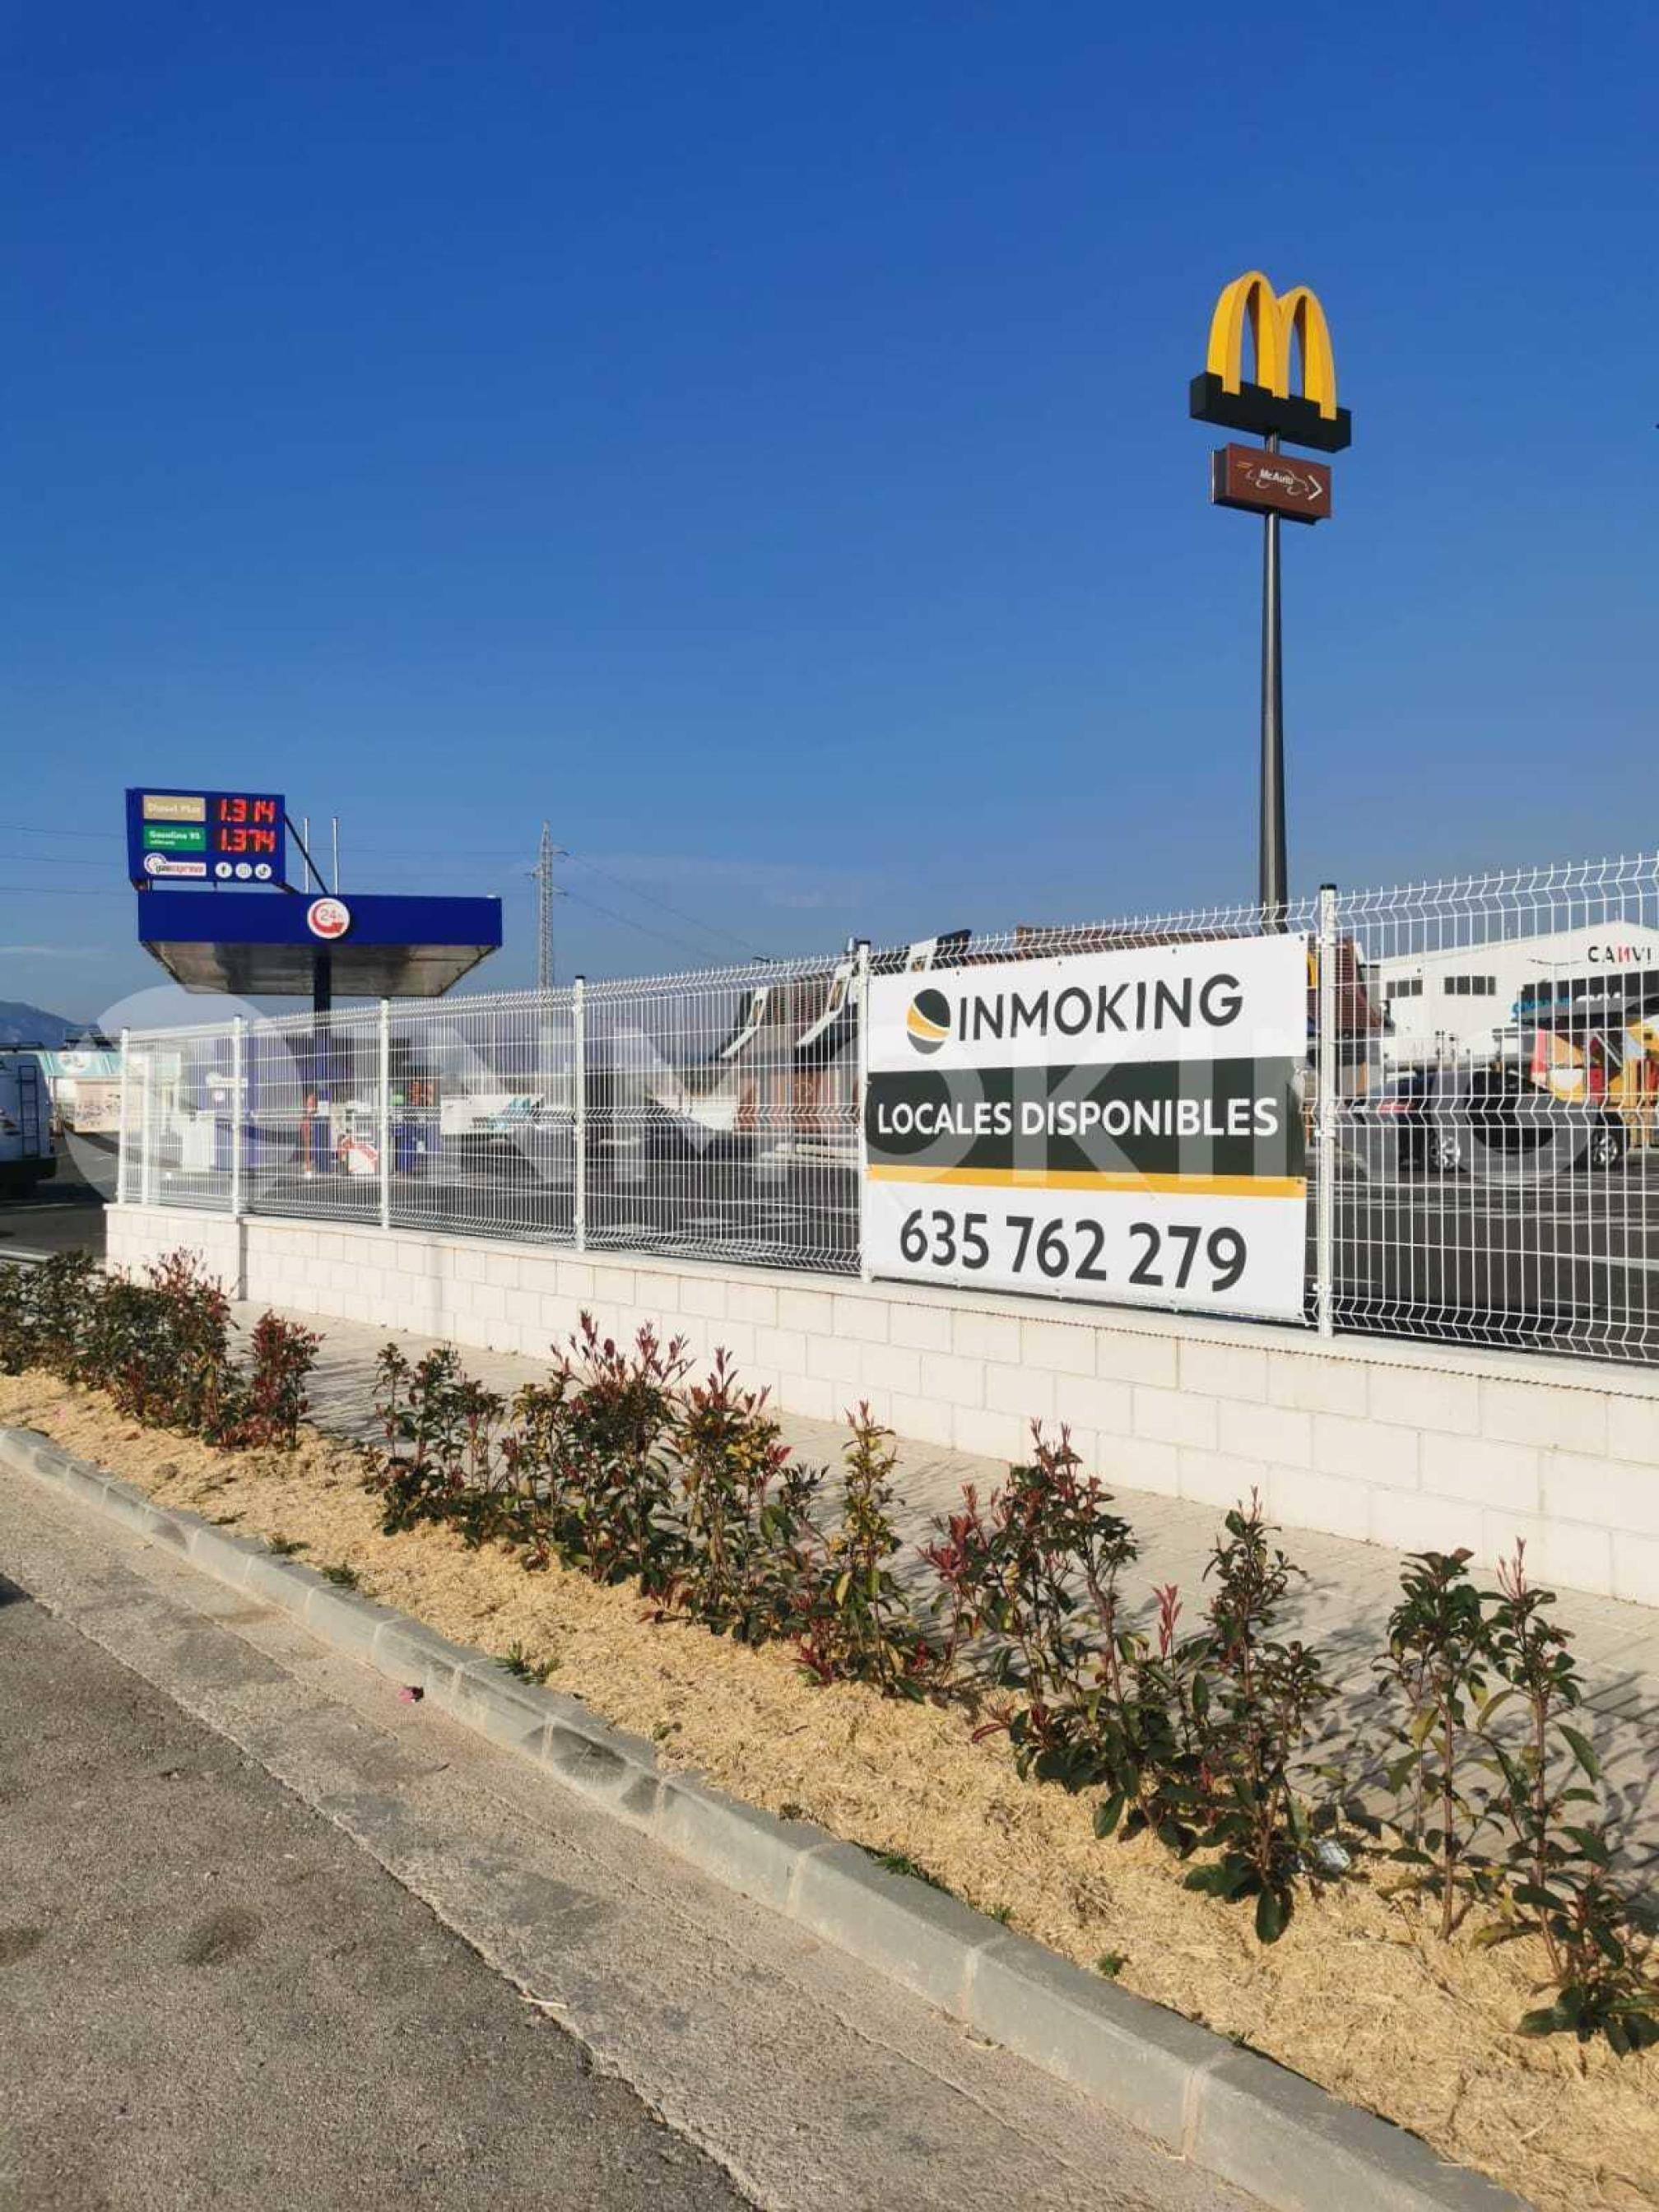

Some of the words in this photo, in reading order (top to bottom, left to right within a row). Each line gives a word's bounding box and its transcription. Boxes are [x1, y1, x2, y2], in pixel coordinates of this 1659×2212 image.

[221, 798, 276, 823] 1.314
[221, 828, 276, 853] 1.374
[959, 974, 1243, 1042] INMOKING
[877, 1103, 1012, 1136] LOCALES
[1020, 1098, 1279, 1136] DISPONIBLES
[899, 1209, 989, 1270] 635
[1006, 1215, 1107, 1281] 762
[1128, 1222, 1247, 1292] 279
